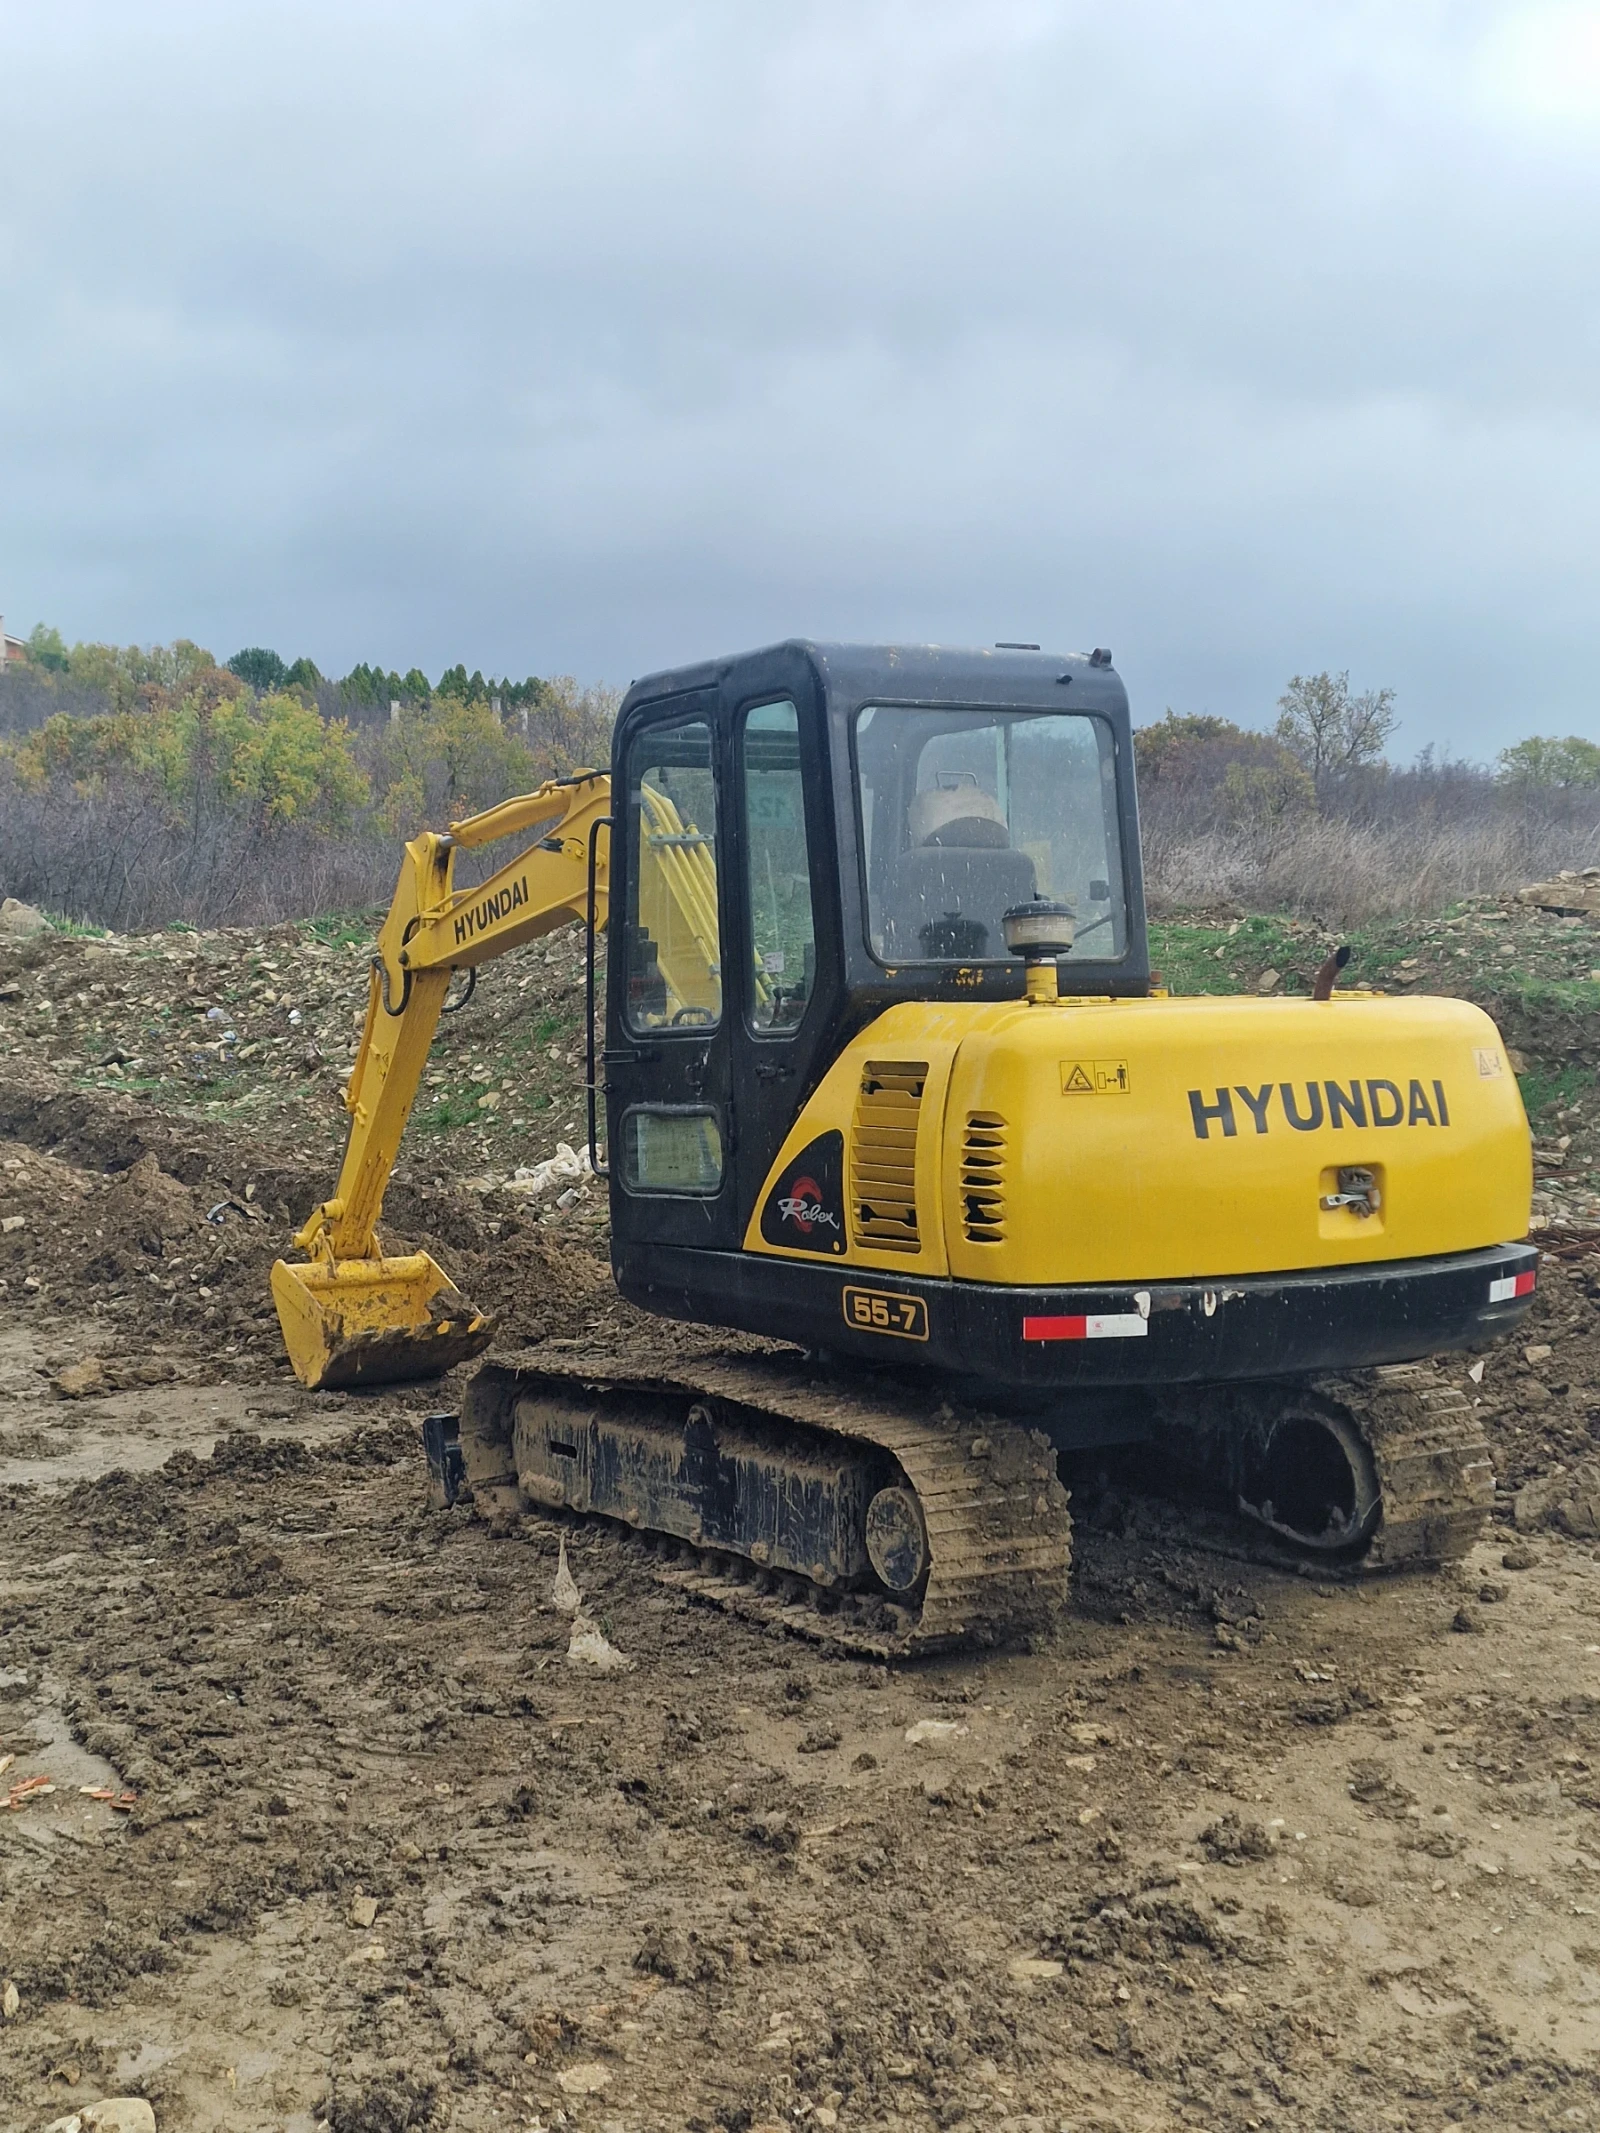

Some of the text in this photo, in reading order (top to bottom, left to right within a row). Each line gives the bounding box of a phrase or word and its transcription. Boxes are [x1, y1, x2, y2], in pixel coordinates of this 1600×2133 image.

[454, 875, 529, 945] HYUNDAI
[1187, 1079, 1450, 1139] HYUNDAI
[777, 1198, 840, 1230] Robex
[854, 1296, 916, 1331] 55-7
